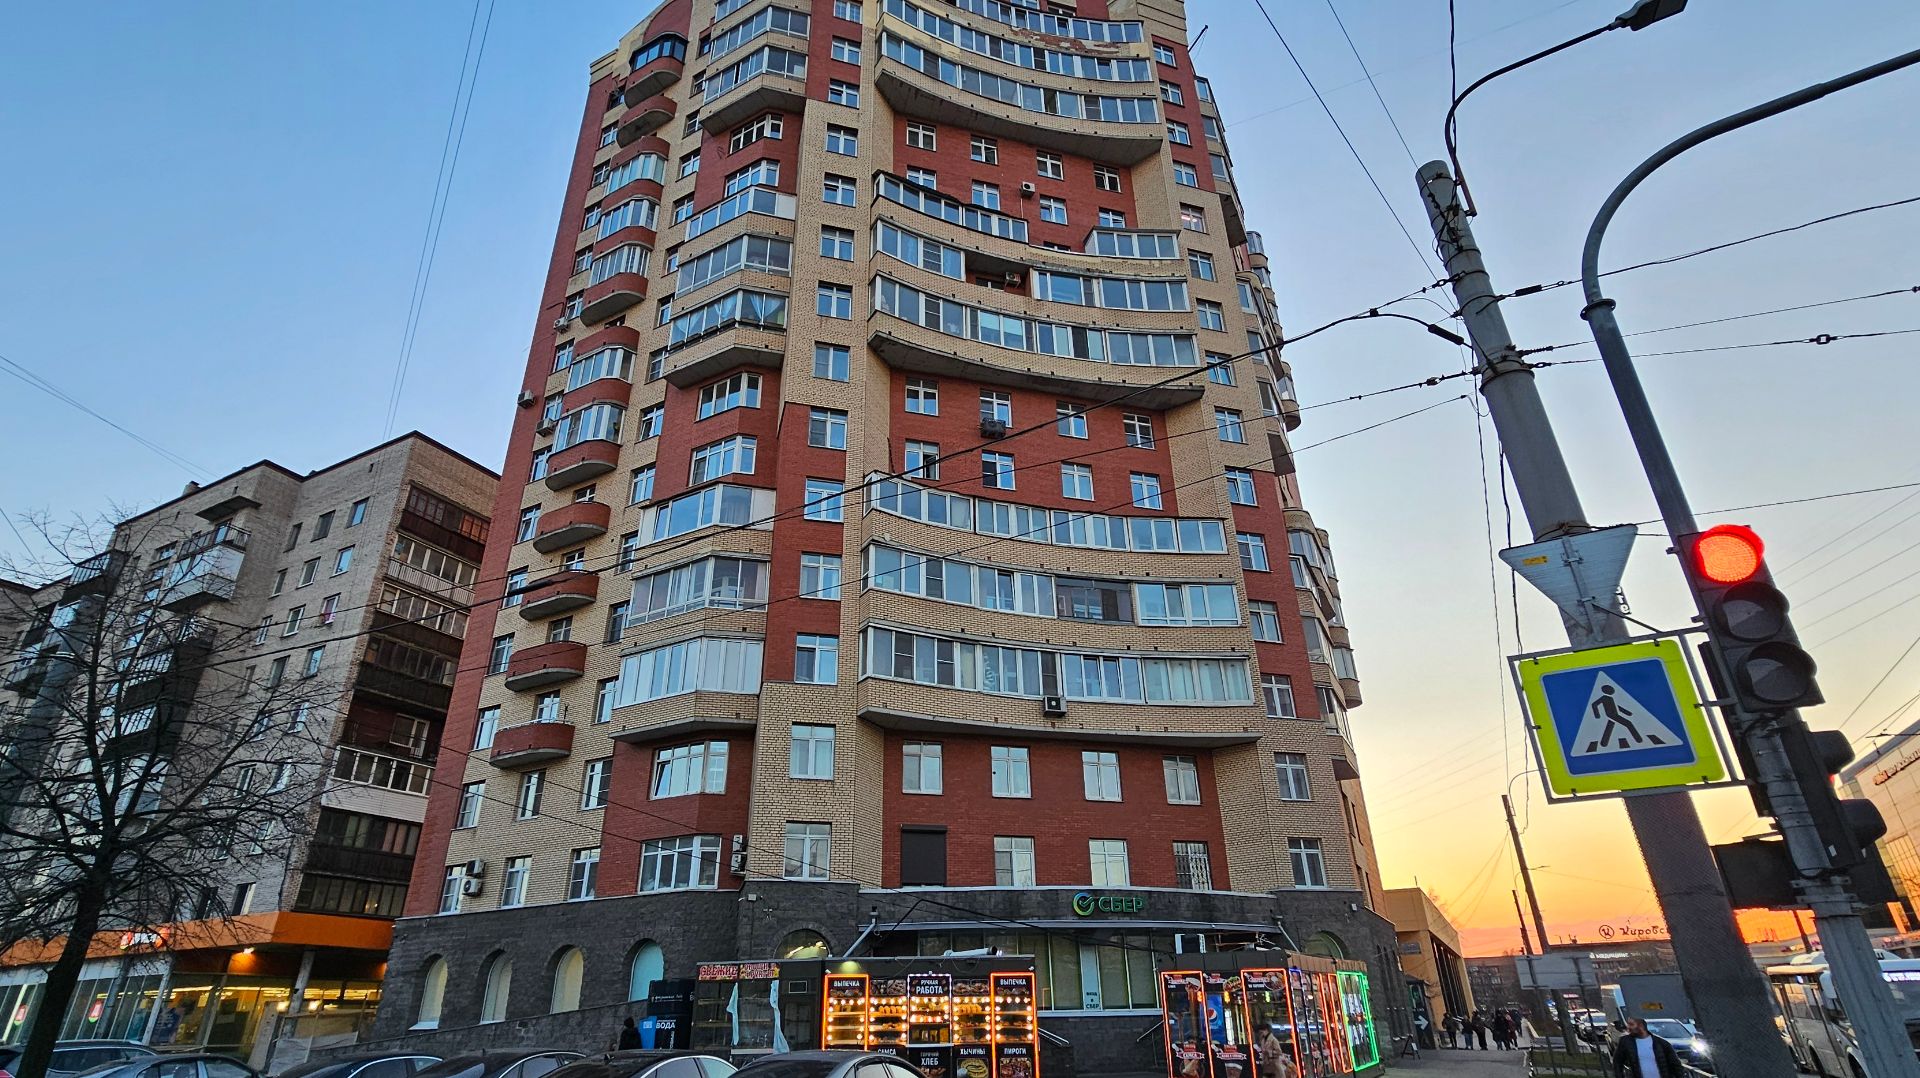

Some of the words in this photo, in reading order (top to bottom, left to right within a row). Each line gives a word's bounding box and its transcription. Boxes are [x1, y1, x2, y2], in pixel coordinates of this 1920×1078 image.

[1099, 896, 1143, 912] СБЕР
[1619, 926, 1664, 937] Кировс
[1000, 978, 1027, 986] ВЫПЕЧКА
[916, 986, 943, 994] РАБОТА
[656, 1022, 675, 1030] ВОДА
[1004, 1047, 1026, 1055] ПИРОГИ
[921, 1058, 939, 1066] ХЛЕБ
